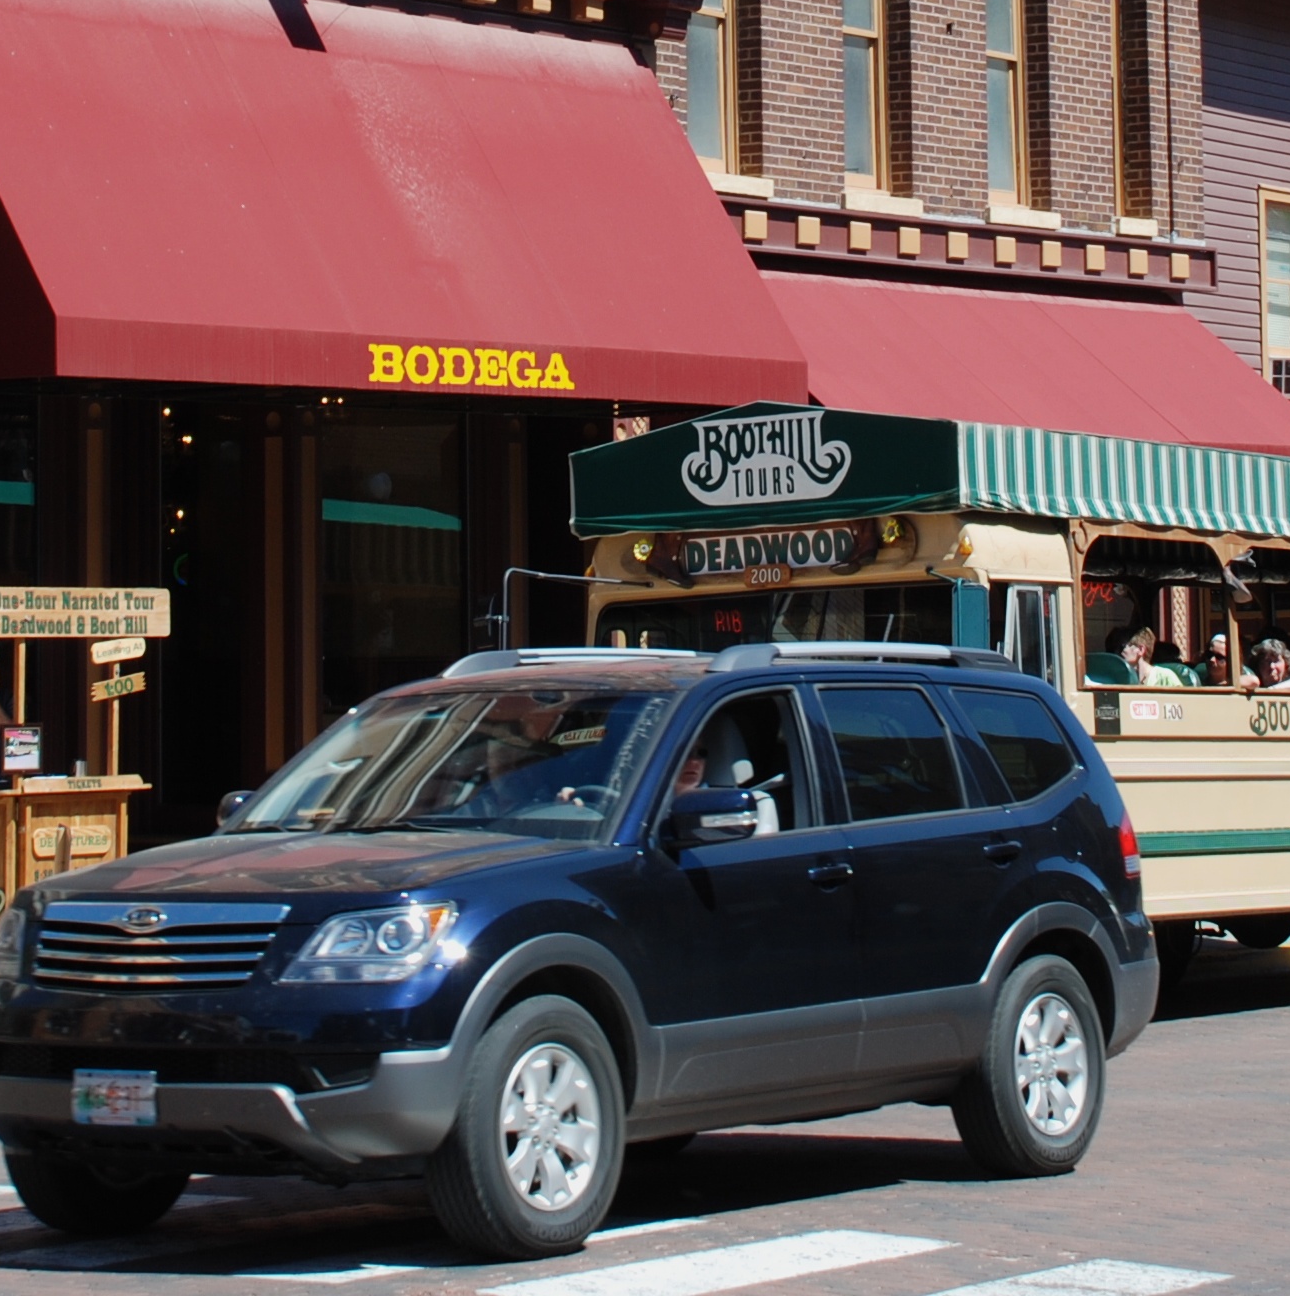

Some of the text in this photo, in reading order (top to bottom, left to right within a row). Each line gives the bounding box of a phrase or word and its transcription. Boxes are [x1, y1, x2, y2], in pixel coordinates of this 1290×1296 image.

[368, 343, 575, 390] BODEGA
[733, 464, 796, 498] TOURS
[687, 529, 854, 573] DEADWOOD
[750, 567, 782, 585] 2010
[61, 591, 120, 610] Narrated
[124, 592, 155, 610] Tour
[1, 615, 148, 635] Deadwood & Boot Hill
[1163, 705, 1183, 720] 1:00
[67, 779, 102, 789] TICKETS
[39, 835, 108, 849] DETURES
